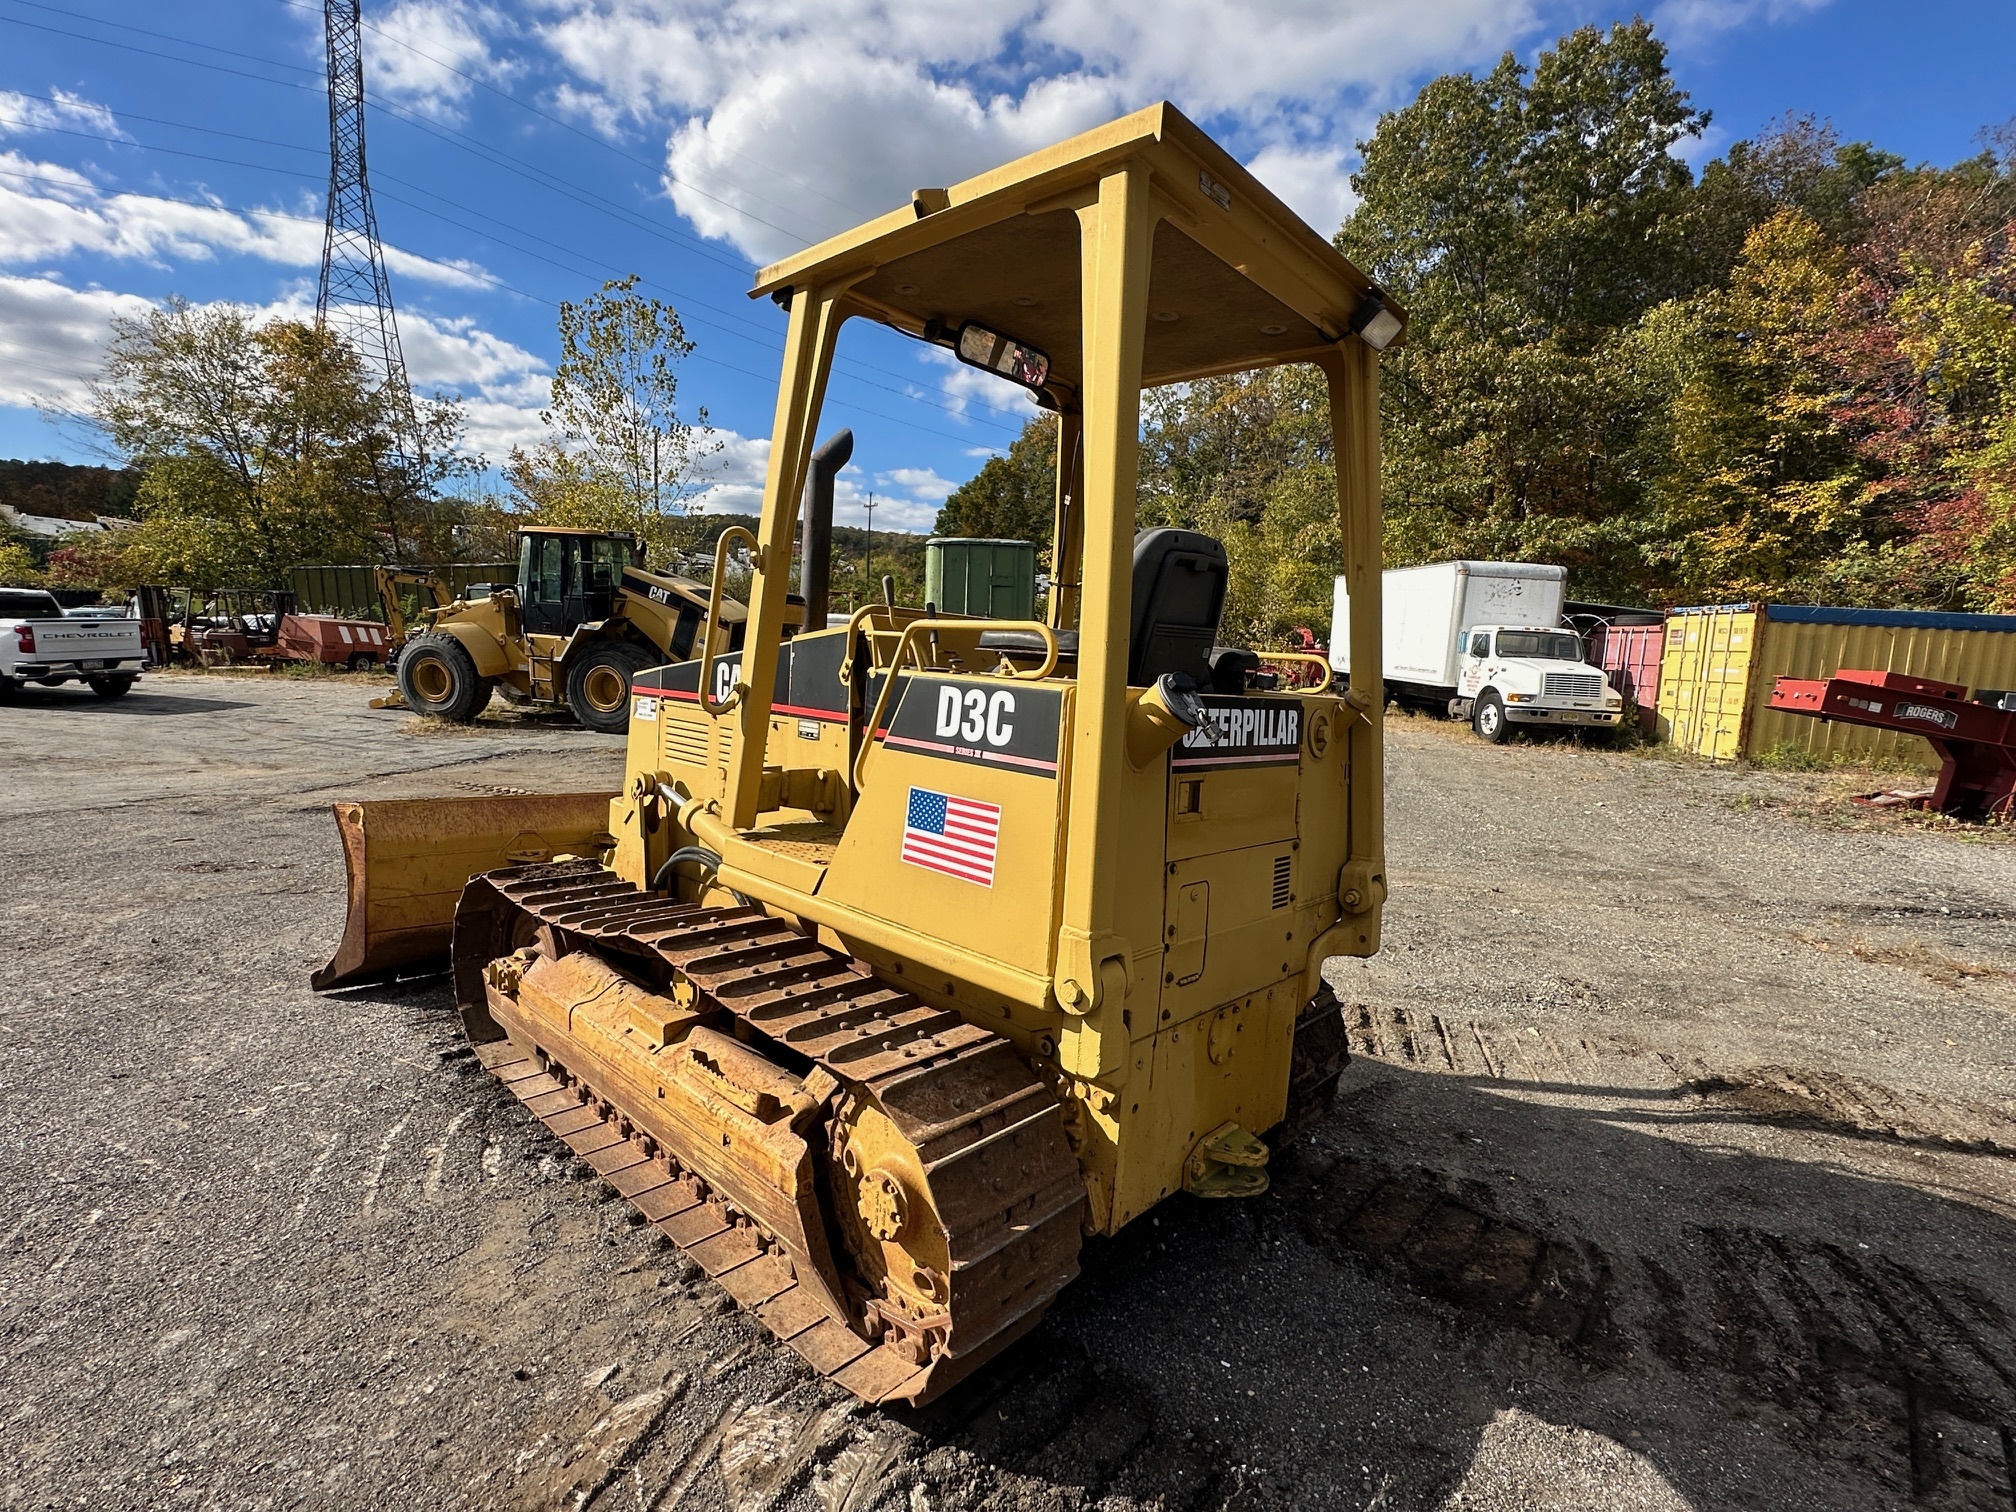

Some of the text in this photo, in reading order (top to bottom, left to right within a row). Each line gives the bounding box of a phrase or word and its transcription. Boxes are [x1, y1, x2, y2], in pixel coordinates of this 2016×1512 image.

[648, 586, 670, 604] CAT
[717, 662, 742, 703] CA
[936, 685, 1015, 746] D3C
[1905, 706, 1945, 723] ROGERS
[955, 746, 974, 757] SERIES
